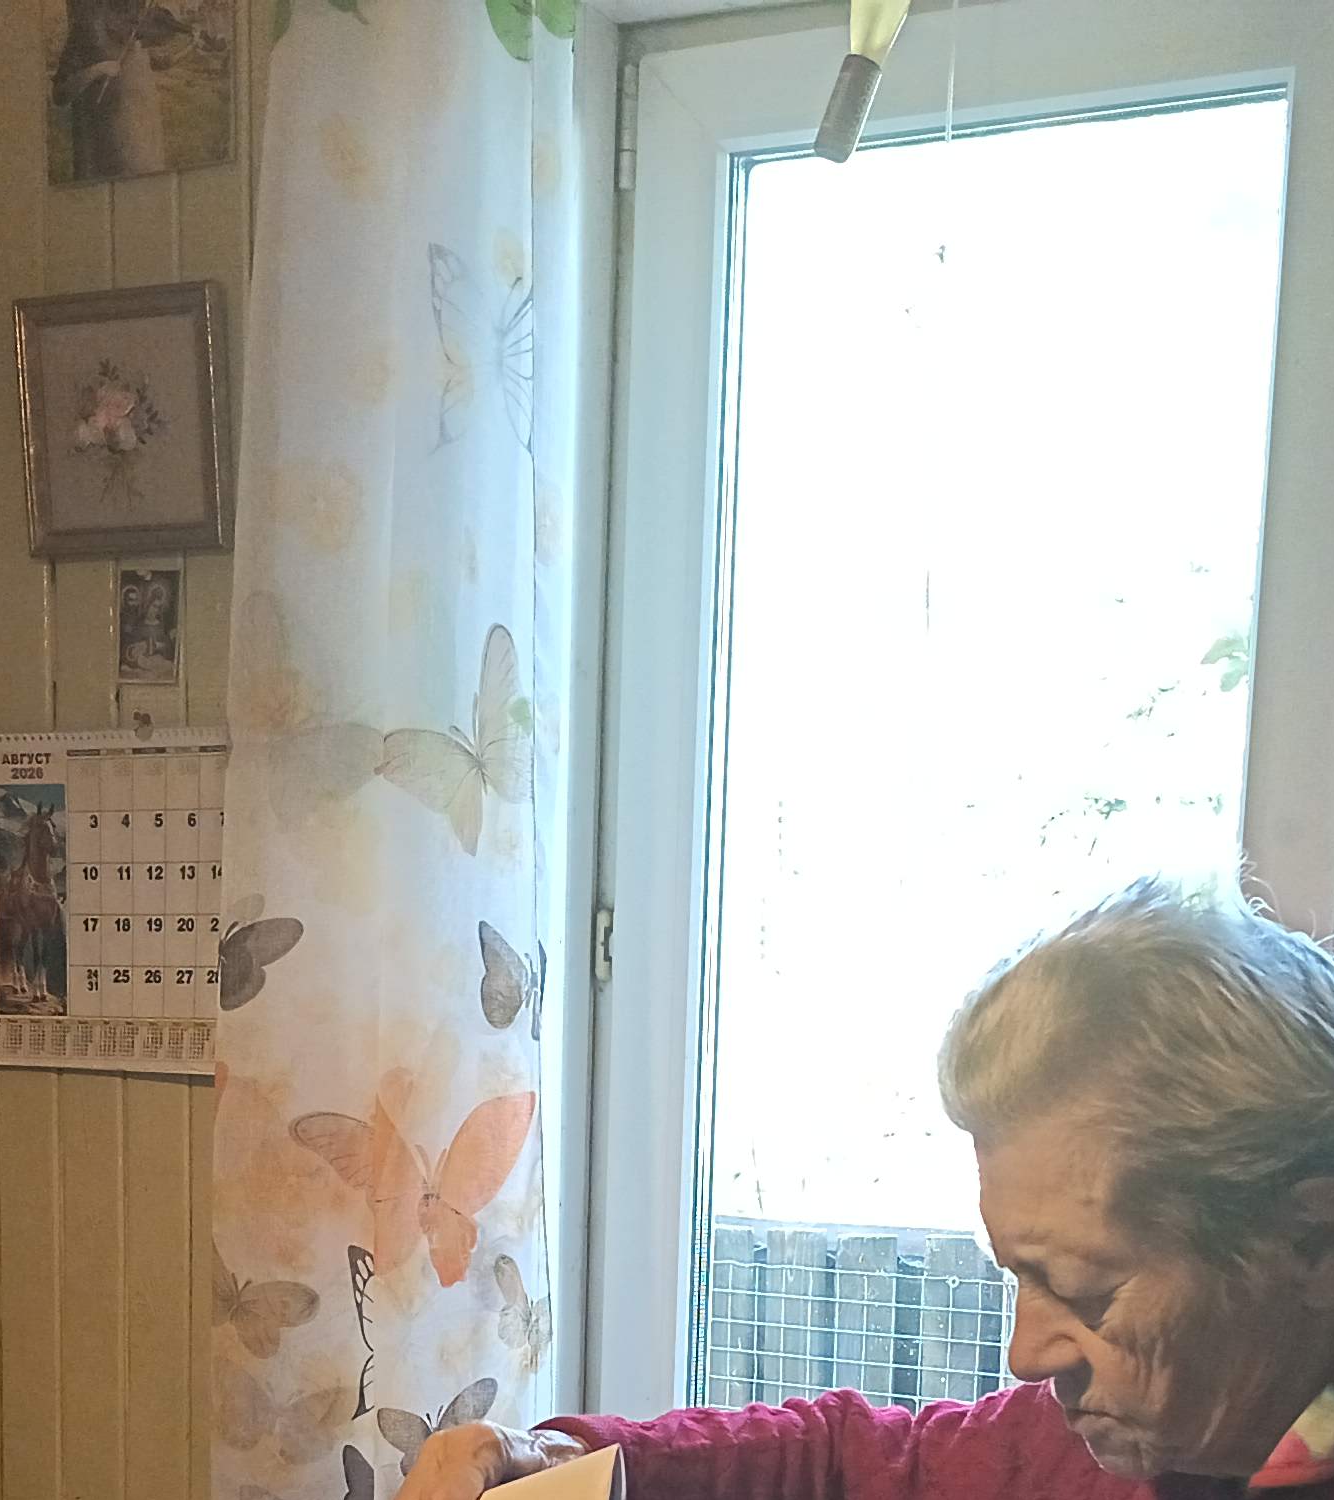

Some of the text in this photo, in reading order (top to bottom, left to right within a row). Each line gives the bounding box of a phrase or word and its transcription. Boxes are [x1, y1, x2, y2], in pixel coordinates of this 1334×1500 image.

[1, 752, 52, 765] АВГУСТ
[10, 767, 44, 780] 2026
[89, 814, 98, 829] 3
[121, 813, 130, 828] 4
[154, 813, 163, 828] 5
[187, 813, 197, 828] 6
[82, 866, 99, 881] 10
[117, 866, 131, 881] 11
[147, 865, 164, 881] 12
[179, 865, 196, 880] 13
[82, 917, 99, 932] 17
[114, 917, 131, 932] 18
[146, 917, 163, 932] 19
[177, 917, 195, 932] 20
[86, 968, 99, 979] 24
[113, 969, 131, 984] 25
[144, 969, 162, 984] 26
[176, 969, 194, 984] 27
[87, 980, 99, 992] 31
